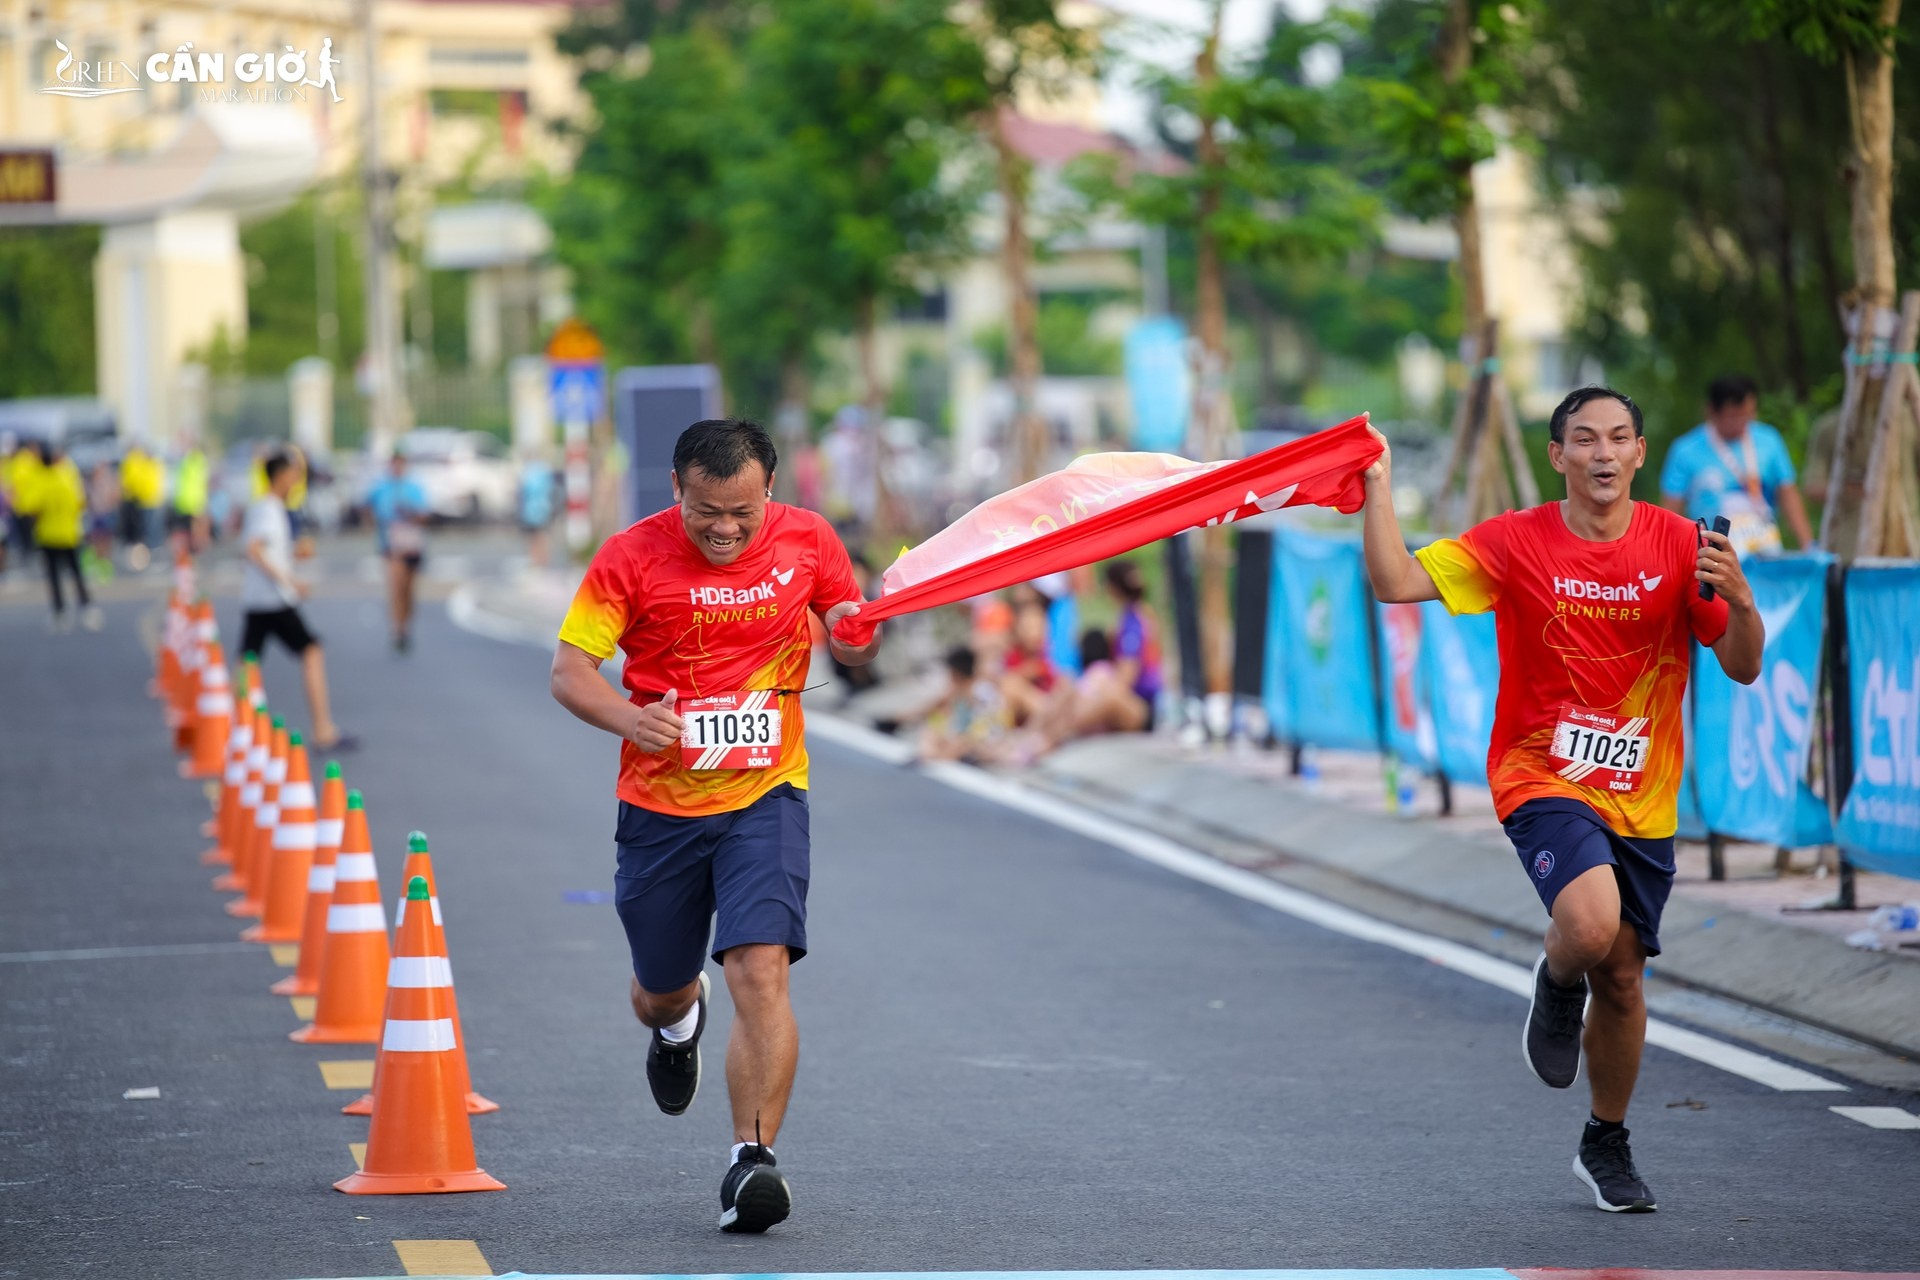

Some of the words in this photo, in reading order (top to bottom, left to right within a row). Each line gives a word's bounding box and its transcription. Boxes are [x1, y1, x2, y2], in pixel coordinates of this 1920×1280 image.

[689, 581, 777, 605] HDBank
[1553, 576, 1641, 601] HDBank
[692, 603, 778, 624] RUNNERS
[1556, 601, 1641, 621] RUNNERS
[694, 713, 770, 745] 11033
[1568, 729, 1640, 769] 11025
[747, 757, 772, 767] 10KM
[1608, 780, 1633, 791] 10KM
